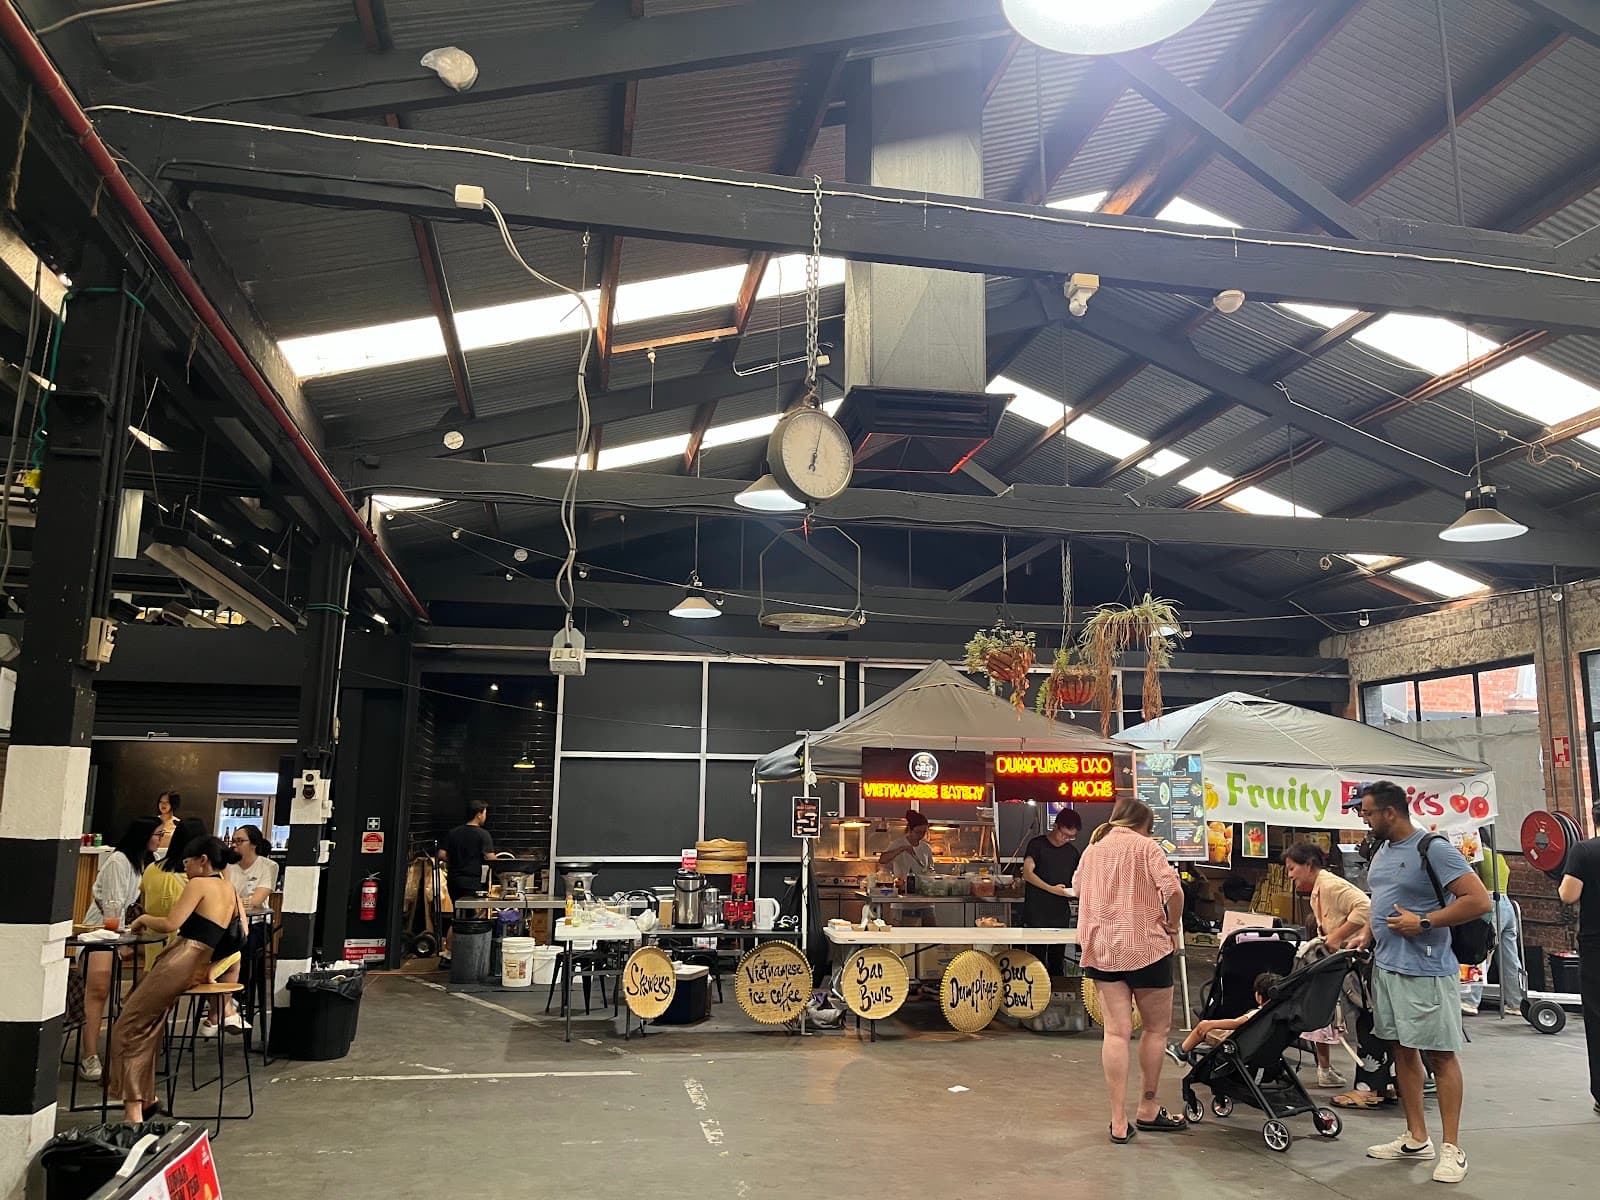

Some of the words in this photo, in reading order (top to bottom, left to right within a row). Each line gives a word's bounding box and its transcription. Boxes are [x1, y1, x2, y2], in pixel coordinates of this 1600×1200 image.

[996, 756, 1079, 773] DUMPLINGS
[1081, 757, 1112, 774] DAO
[863, 782, 939, 799] VIETNAMESE
[940, 784, 985, 801] EATERY
[1072, 781, 1113, 797] MORE
[1226, 772, 1331, 822] Fruity
[1341, 780, 1445, 816] Fits
[745, 953, 804, 984] Vietnamese
[856, 956, 883, 985] Bao
[748, 987, 767, 1004] ice
[770, 981, 803, 1012] coffee
